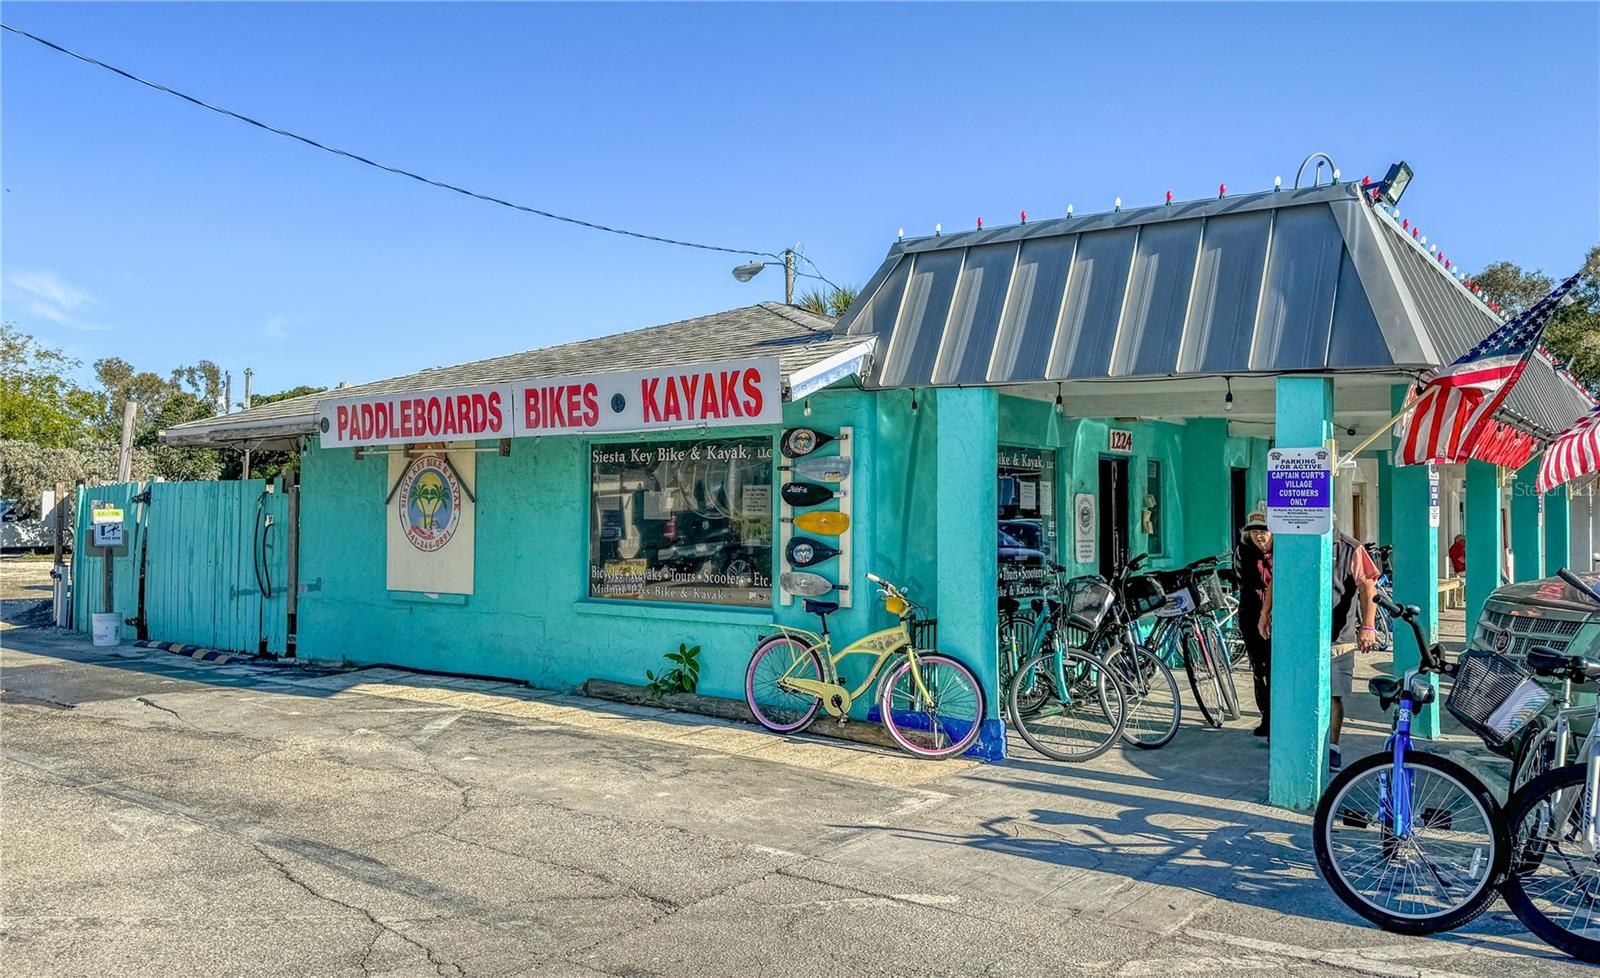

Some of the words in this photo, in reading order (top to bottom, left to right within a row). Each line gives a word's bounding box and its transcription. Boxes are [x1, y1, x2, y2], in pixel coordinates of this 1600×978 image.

[336, 391, 503, 441] PADDLEBOARDS
[524, 382, 599, 429] BIKES
[641, 367, 763, 423] KAYAKS
[1111, 431, 1132, 451] 1224
[592, 450, 626, 463] Siesta
[630, 448, 653, 464] Key
[657, 446, 685, 462] Bike
[690, 445, 701, 460] &
[706, 444, 752, 463] Kayak,
[757, 447, 773, 458] LLC
[1012, 453, 1019, 466] &
[1021, 453, 1045, 470] Kayak,
[1271, 471, 1300, 479] CAPTAIN
[1300, 471, 1325, 479] CURT'S
[1285, 480, 1313, 488] VILLAGE
[401, 477, 413, 508] SIESTA
[412, 461, 426, 474] KEY
[426, 458, 442, 468] BIKE
[447, 474, 461, 511] KAYAK
[1279, 489, 1319, 497] CUSTOMERS
[1290, 498, 1307, 506] ONLY
[408, 530, 451, 550] 941-346-0891
[591, 565, 624, 581] Bicycles
[631, 567, 662, 583] Kayaks
[669, 567, 696, 582] Tours
[703, 569, 745, 585] Scooters
[753, 571, 773, 587] Etc.
[655, 586, 676, 597] Bike
[680, 587, 688, 598] &
